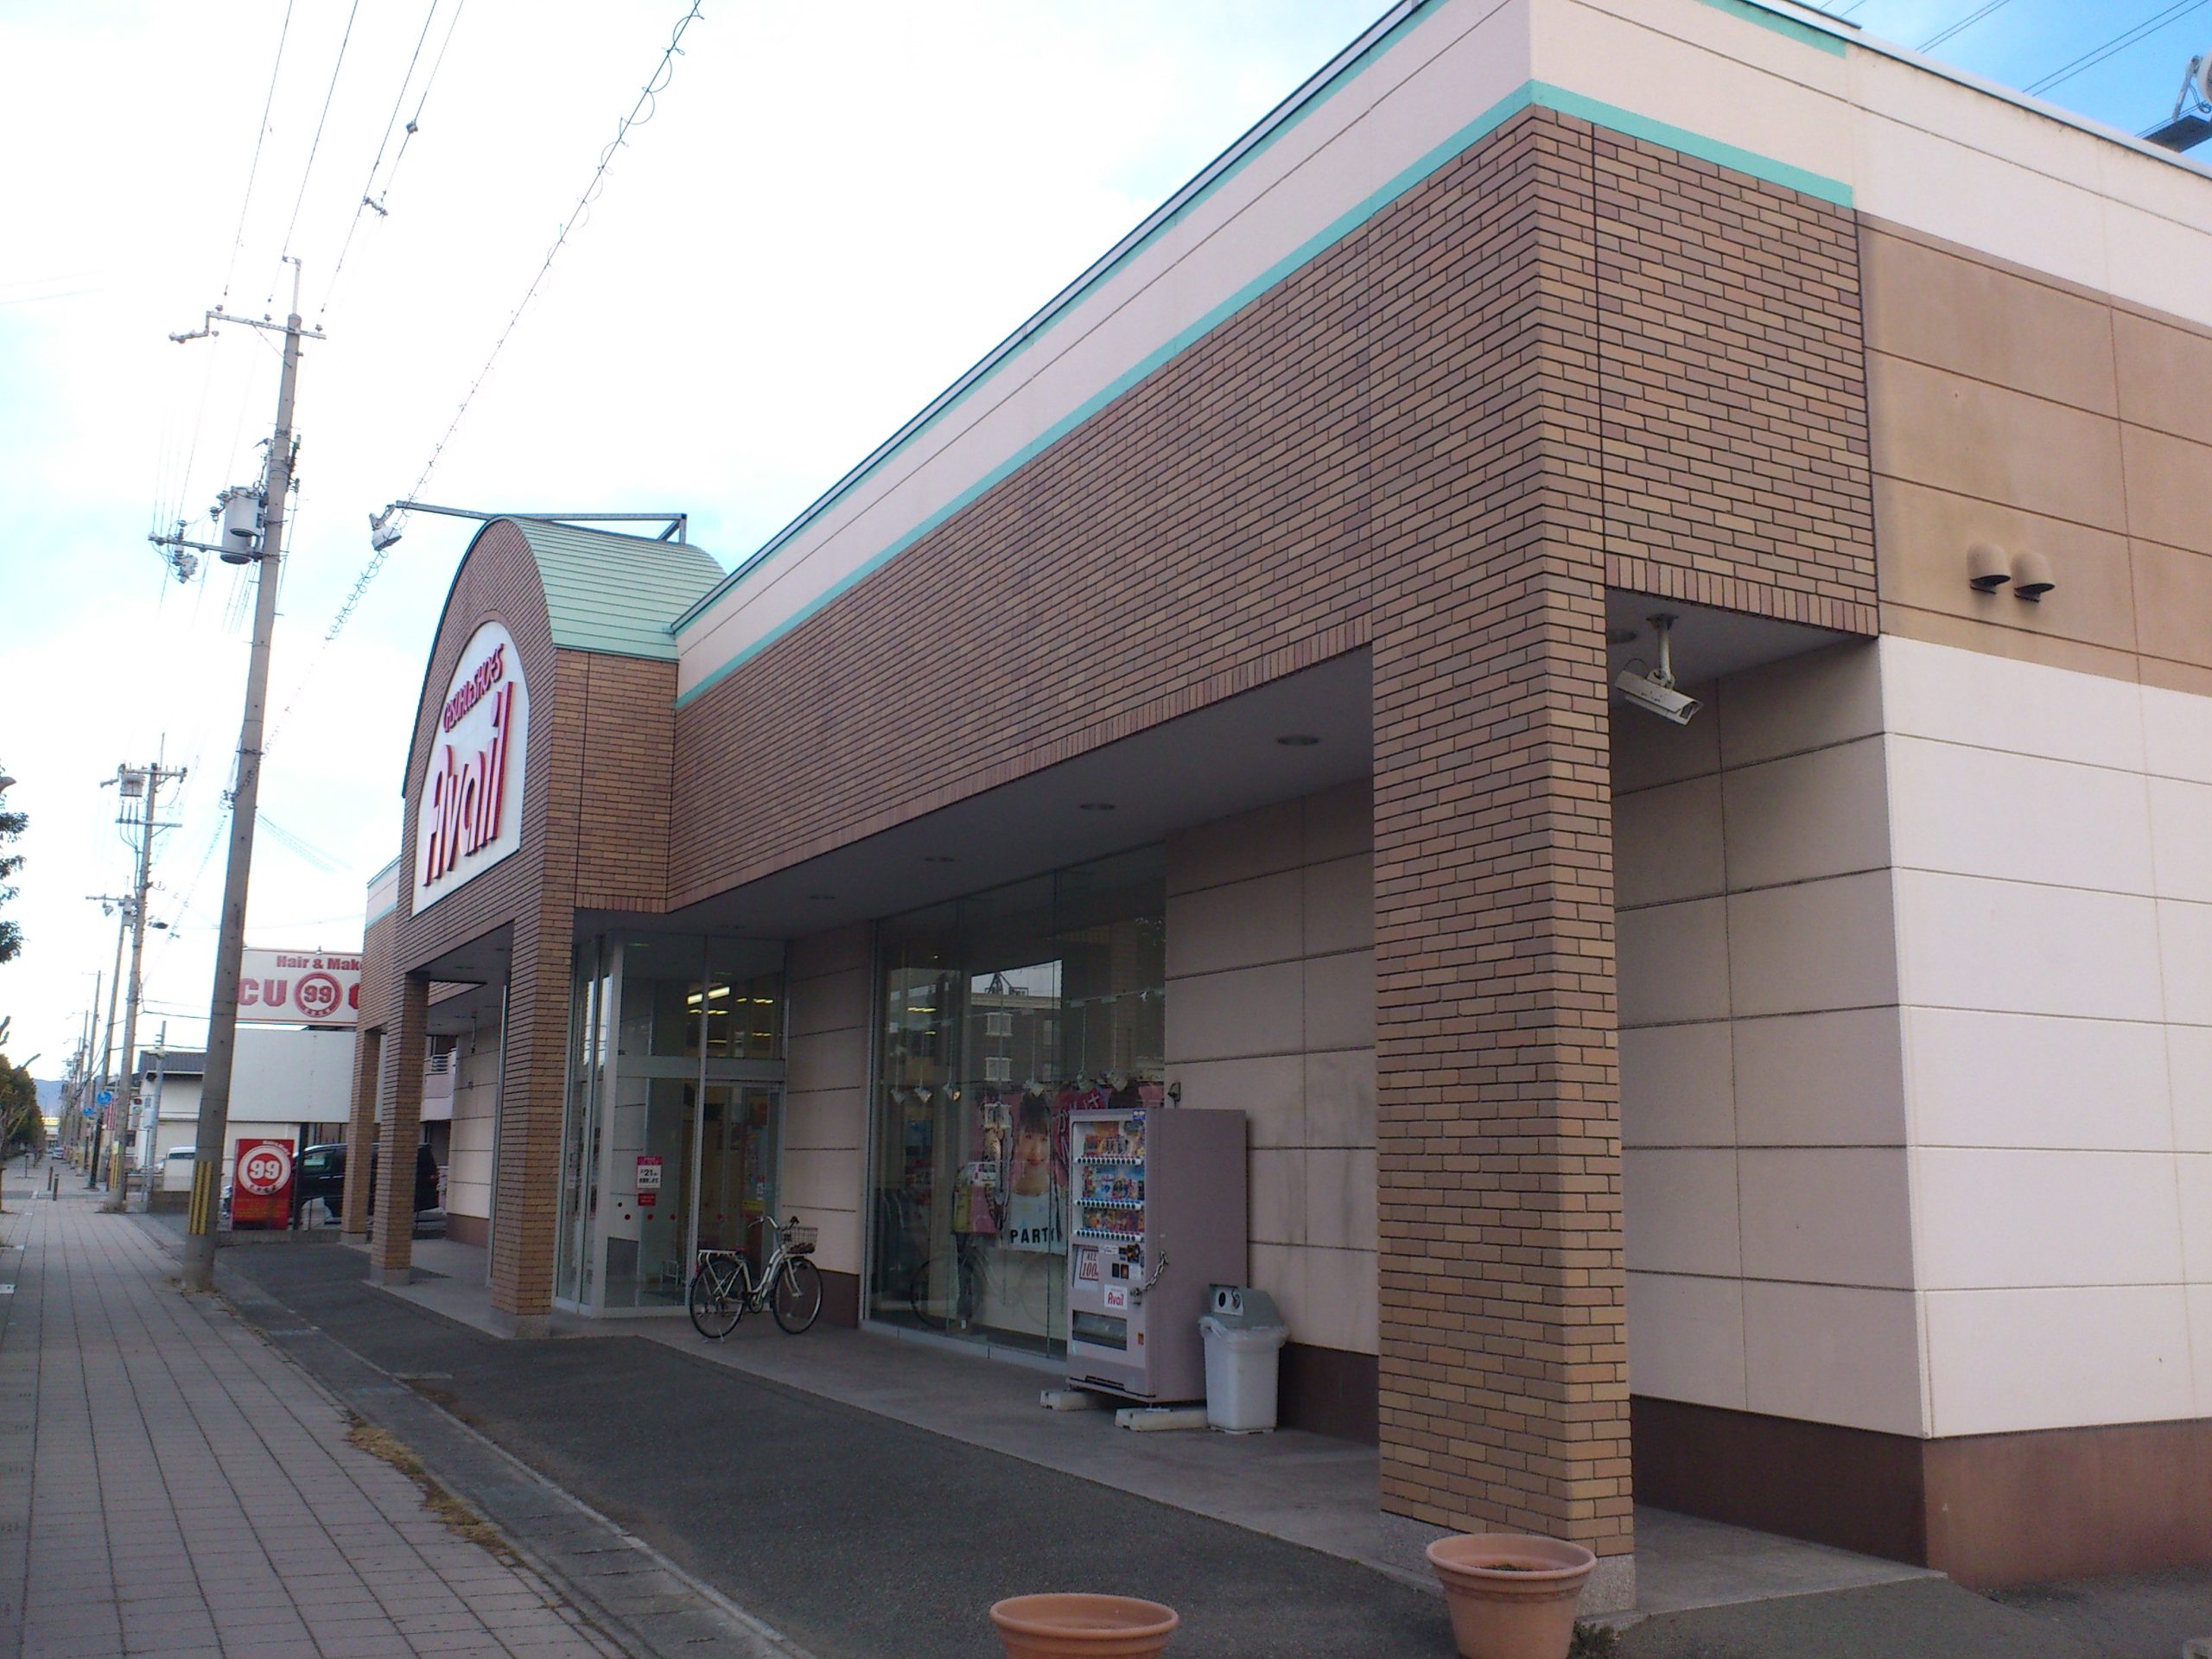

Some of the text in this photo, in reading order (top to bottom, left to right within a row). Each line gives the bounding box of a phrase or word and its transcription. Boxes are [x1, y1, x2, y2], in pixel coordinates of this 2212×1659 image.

[422, 681, 514, 887] Avail
[276, 955, 362, 970] Hair & Mak
[303, 984, 332, 1003] 99
[249, 1160, 280, 1179] 99
[1108, 1292, 1124, 1306] Avail
